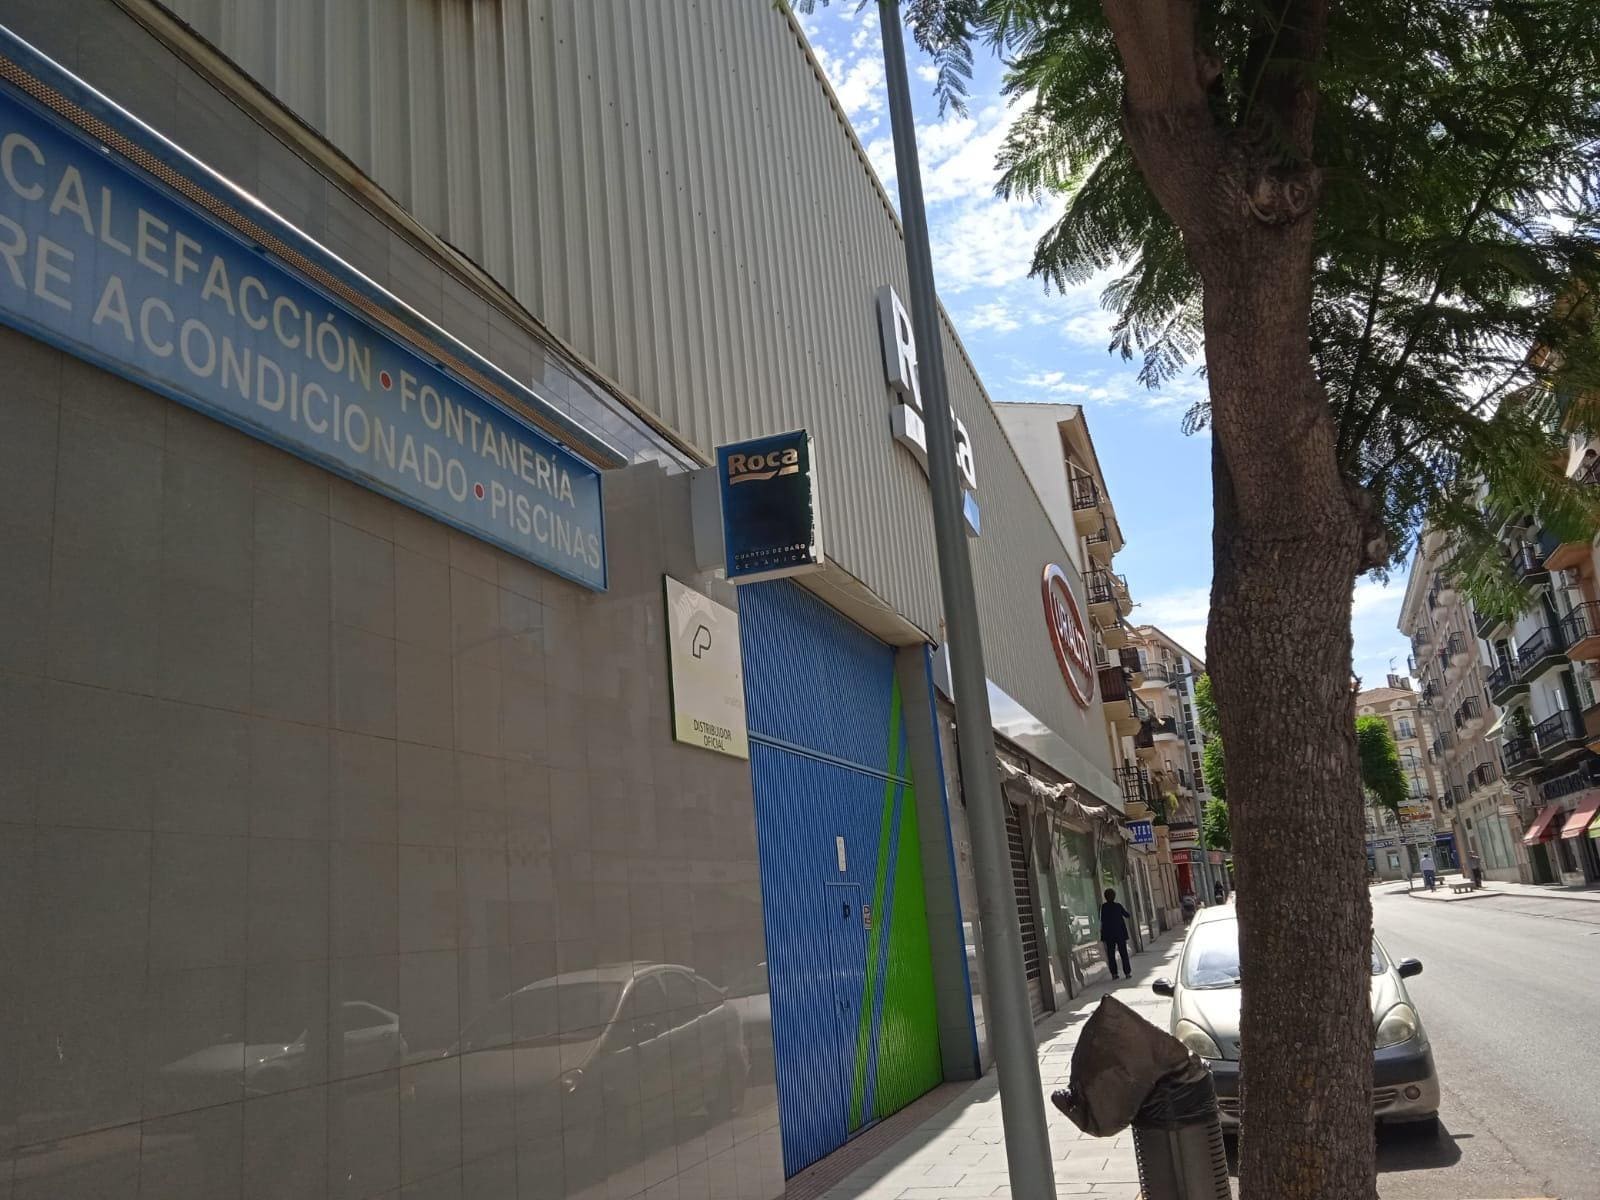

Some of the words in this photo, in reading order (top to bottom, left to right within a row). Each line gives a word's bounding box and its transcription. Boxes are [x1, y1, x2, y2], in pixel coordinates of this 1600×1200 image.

[1, 132, 371, 392] CALEFACCIÓN
[400, 368, 576, 508] FONTANERÍA
[92, 274, 468, 502] ACONDICIONADO
[490, 480, 600, 569] PISCINAS
[727, 447, 798, 475] Roca
[735, 549, 771, 561] CUARTOS
[772, 546, 782, 554] DE
[735, 553, 807, 570] CEAMICA
[693, 719, 732, 742] DISTRIBUIDOR
[704, 734, 726, 751] OFICIAL
